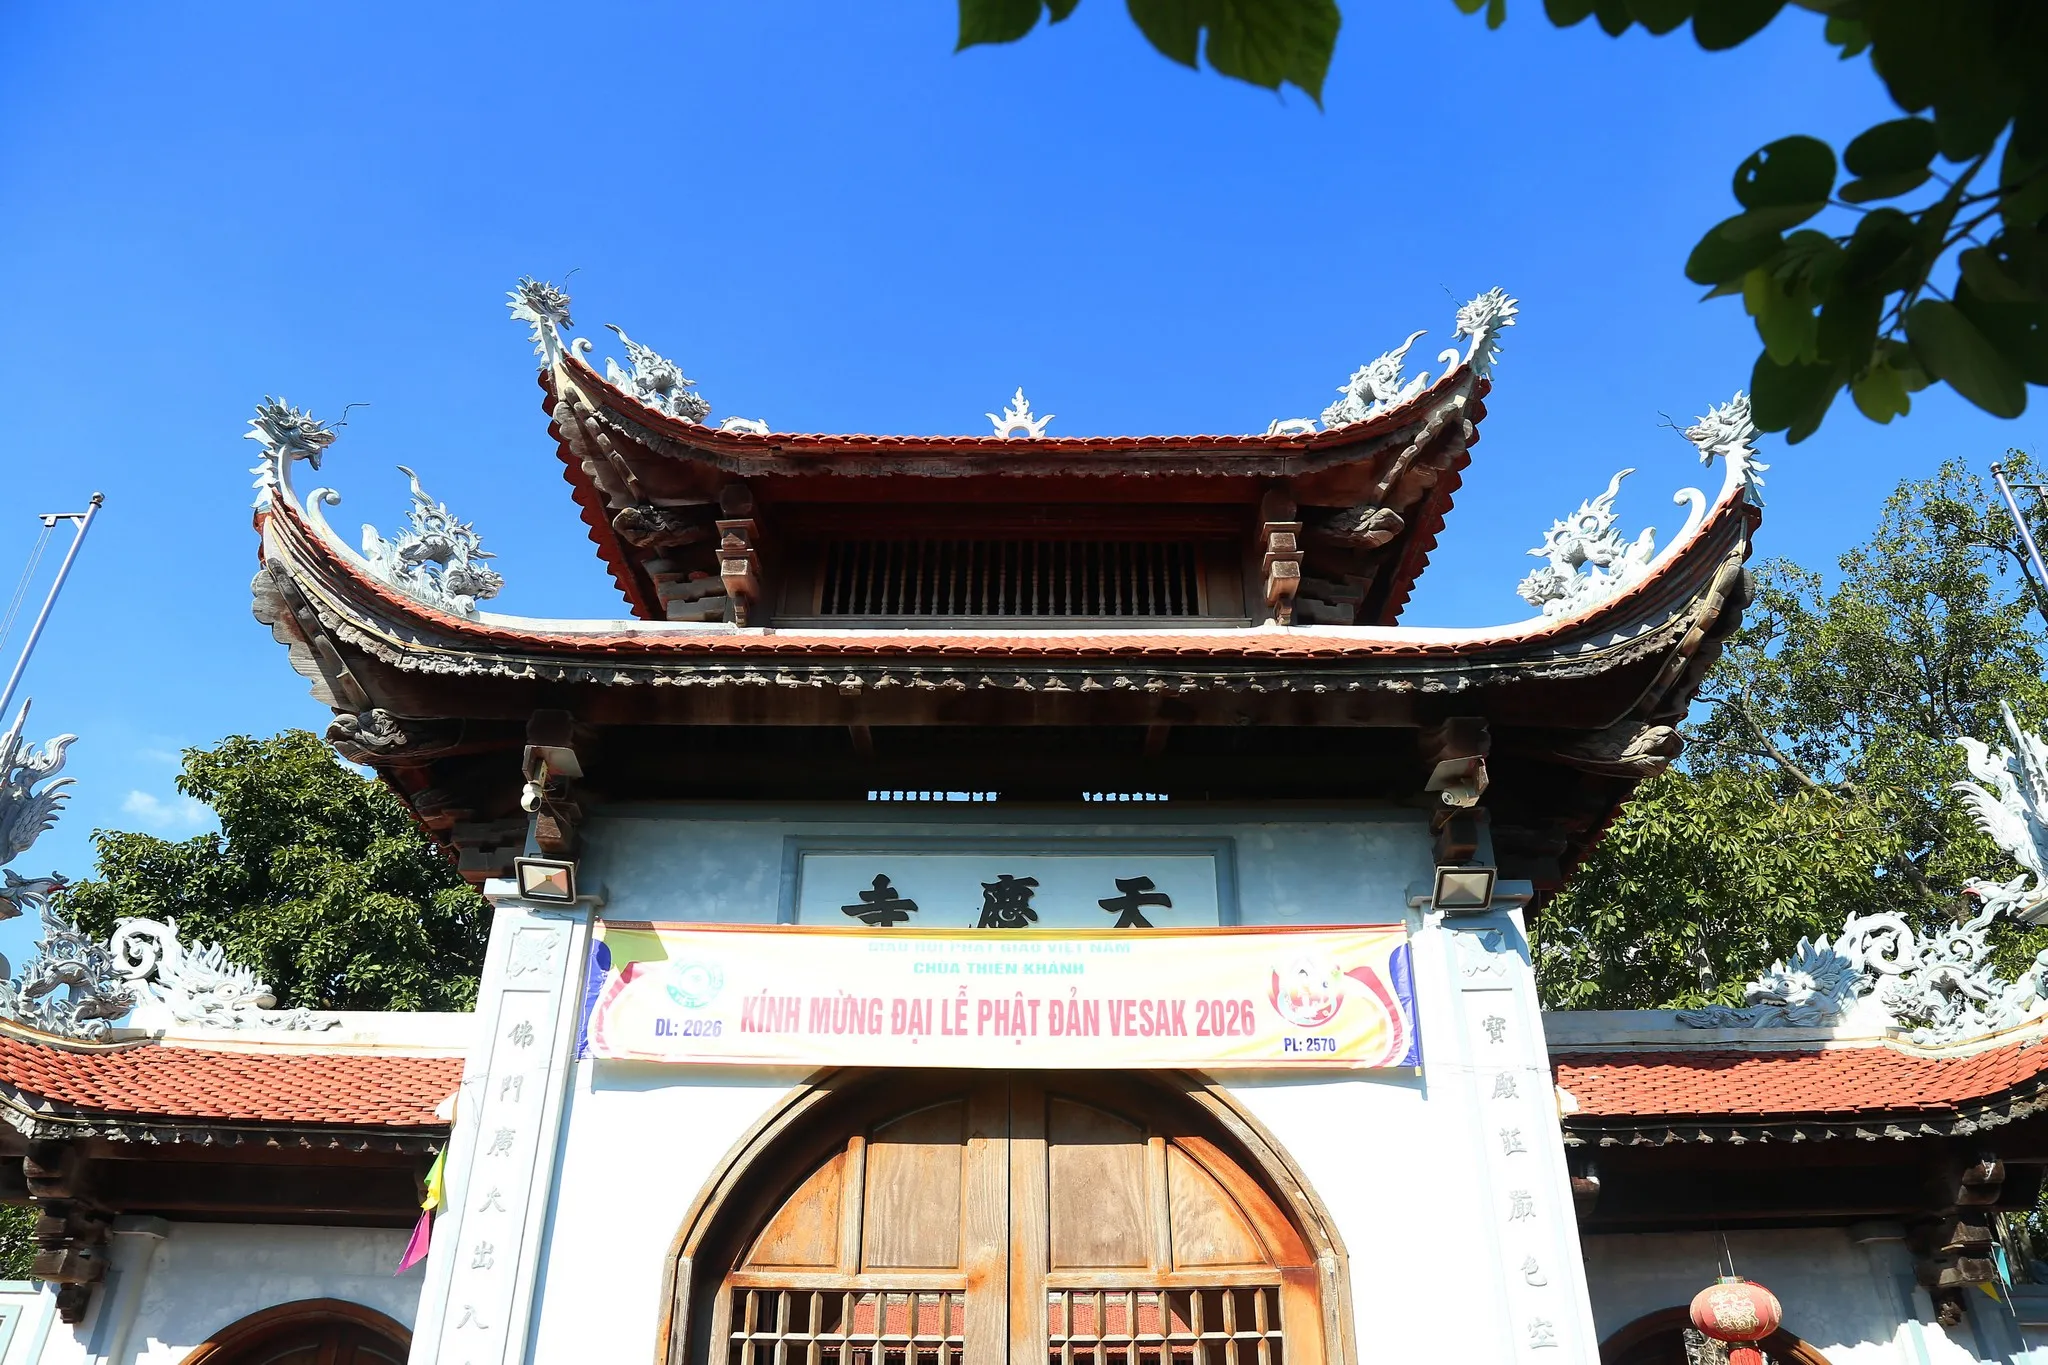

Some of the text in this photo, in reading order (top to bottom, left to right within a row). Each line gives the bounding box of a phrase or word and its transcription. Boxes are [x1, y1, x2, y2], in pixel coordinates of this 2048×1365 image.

[655, 1018, 722, 1038] DL: 2026
[740, 984, 1256, 1045] KÍNH MỪNG ĐẠI LỄ PHẬT ĐẢN VESAK 2026
[1283, 1037, 1336, 1052] PL: 2570
[456, 1020, 536, 1365] 佛門廣大出入
